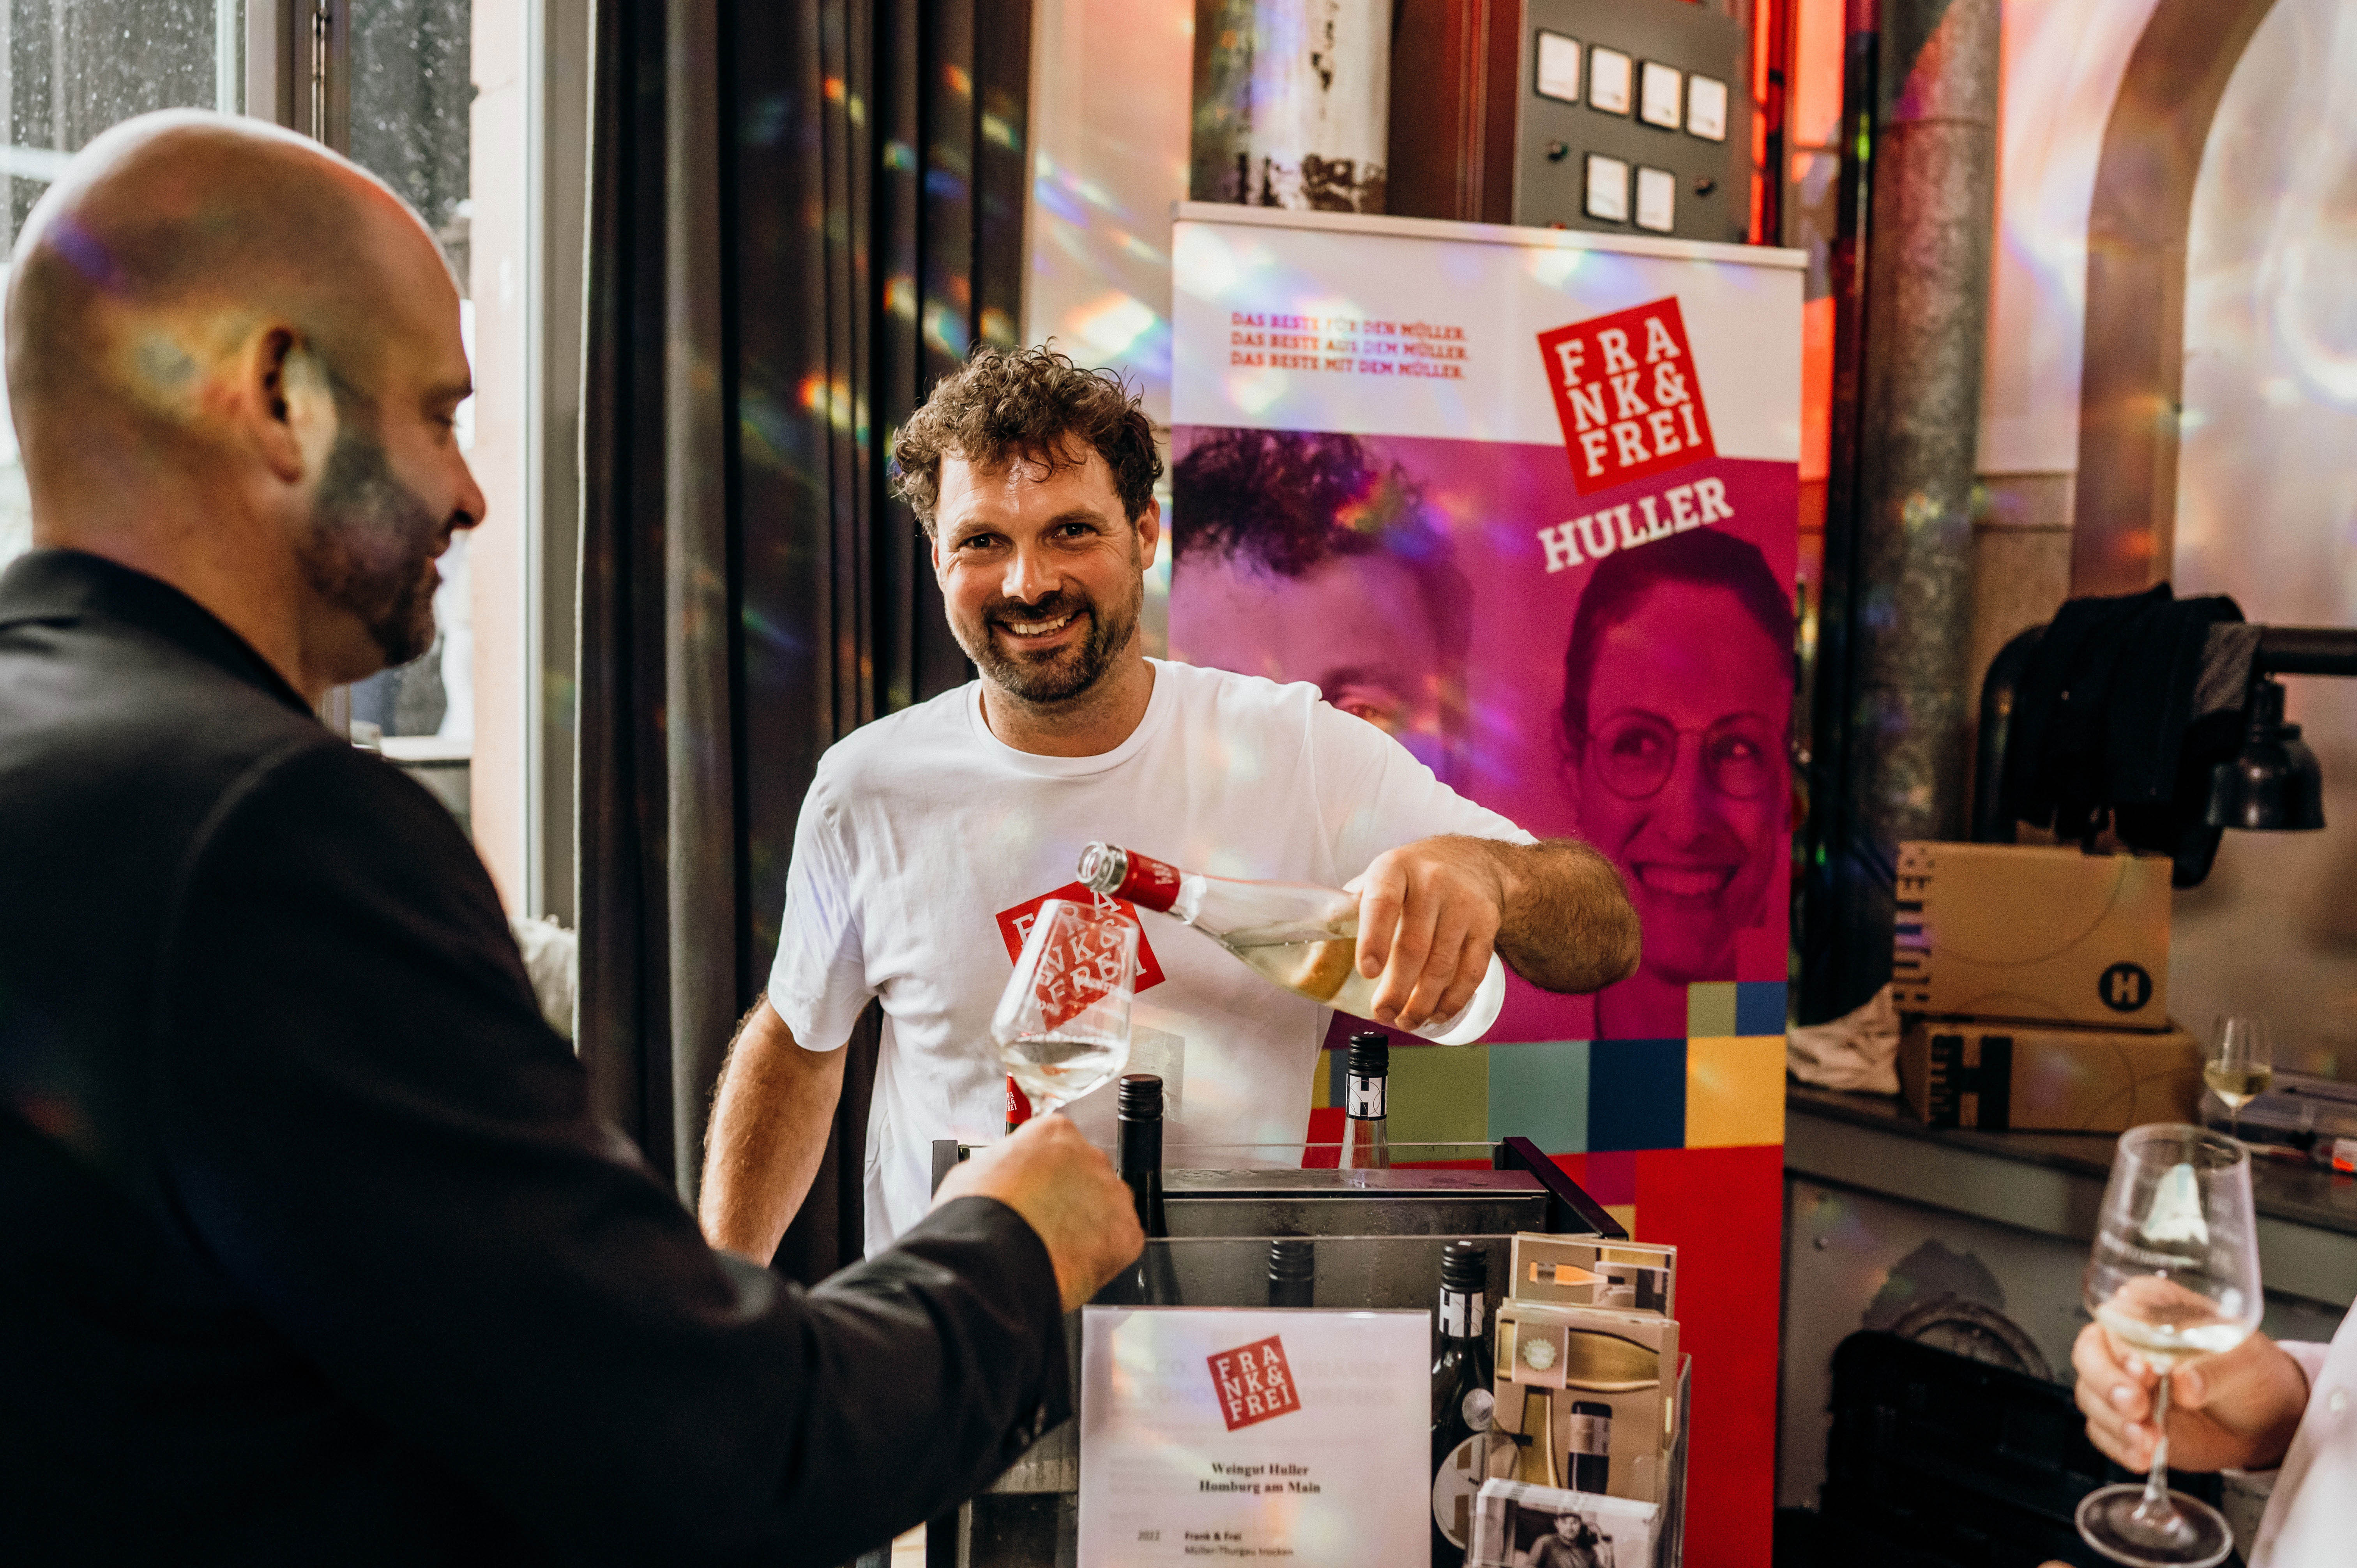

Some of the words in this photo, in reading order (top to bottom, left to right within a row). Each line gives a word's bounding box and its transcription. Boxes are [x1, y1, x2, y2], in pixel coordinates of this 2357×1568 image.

[1231, 312, 1264, 327] DAS
[1270, 315, 1319, 330] BESTE
[1231, 331, 1264, 346] DAS
[1270, 334, 1319, 350] BESTE
[1326, 339, 1357, 352] AUS
[1231, 350, 1264, 366] DAS
[1270, 353, 1319, 370] BESTE
[1326, 357, 1353, 372] MIT
[1360, 359, 1394, 375] DEM
[1567, 360, 1691, 432] NK&
[1579, 403, 1702, 478] FREI
[1537, 476, 1735, 574] HULLER
[1348, 1075, 1382, 1117] H
[1223, 1365, 1285, 1400] NK&
[1229, 1384, 1292, 1422] FREI
[1212, 1462, 1265, 1477] Weingut
[1269, 1463, 1309, 1476] Huller
[1199, 1480, 1260, 1495] Homburg
[1265, 1484, 1283, 1493] am
[1288, 1481, 1321, 1494] Main
[1184, 1530, 1210, 1541] Frank
[1214, 1531, 1221, 1541] &
